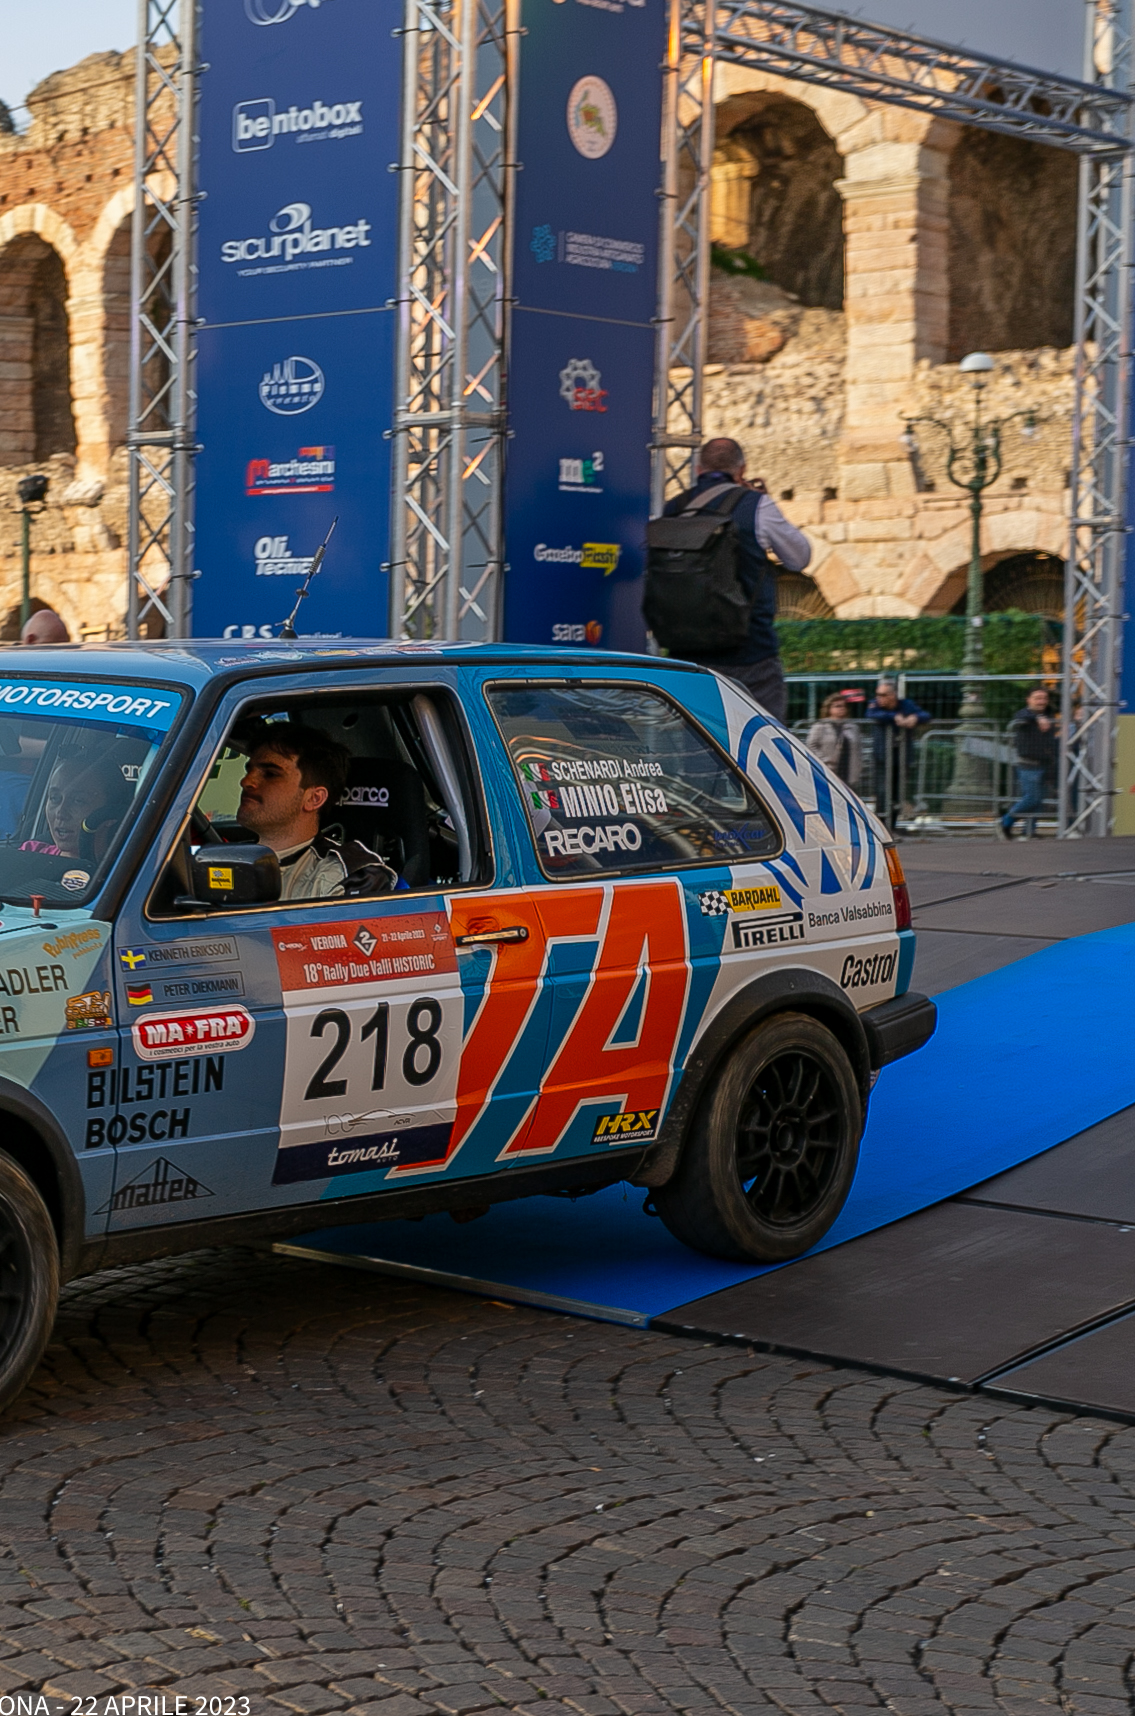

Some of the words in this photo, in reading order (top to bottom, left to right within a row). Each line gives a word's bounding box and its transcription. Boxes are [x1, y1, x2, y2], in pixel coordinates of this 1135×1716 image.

[236, 100, 363, 140] bentobox
[552, 624, 586, 641] sara
[551, 760, 621, 781] SCHENARDI
[623, 759, 664, 778] Andrea
[340, 787, 389, 806] parco
[558, 784, 620, 818] MINIO
[619, 782, 669, 815] Elisa
[544, 822, 642, 857] RECARO
[730, 888, 781, 909] BARDAHL
[808, 912, 840, 928] Banca
[840, 901, 893, 922] Valsabbina
[310, 934, 349, 951] VERONA
[731, 911, 805, 949] PIRELLI
[148, 949, 190, 962] KENNETH
[190, 942, 232, 957] ERIKSSON
[323, 962, 349, 982] Rally
[349, 961, 370, 978] Due
[370, 957, 393, 975] Valli
[393, 953, 436, 974] HISTORIC
[840, 949, 899, 990] Castrol
[164, 983, 191, 997] PETER
[192, 978, 239, 994] DIEKMANN
[225, 1039, 240, 1047] auto
[303, 996, 444, 1101] 218
[87, 1056, 225, 1109] BILSTEIN
[85, 1107, 192, 1149] BOSCH
[596, 1110, 658, 1136] HRX
[620, 1129, 654, 1139] MOTORSPORT
[328, 1137, 401, 1166] tomasi
